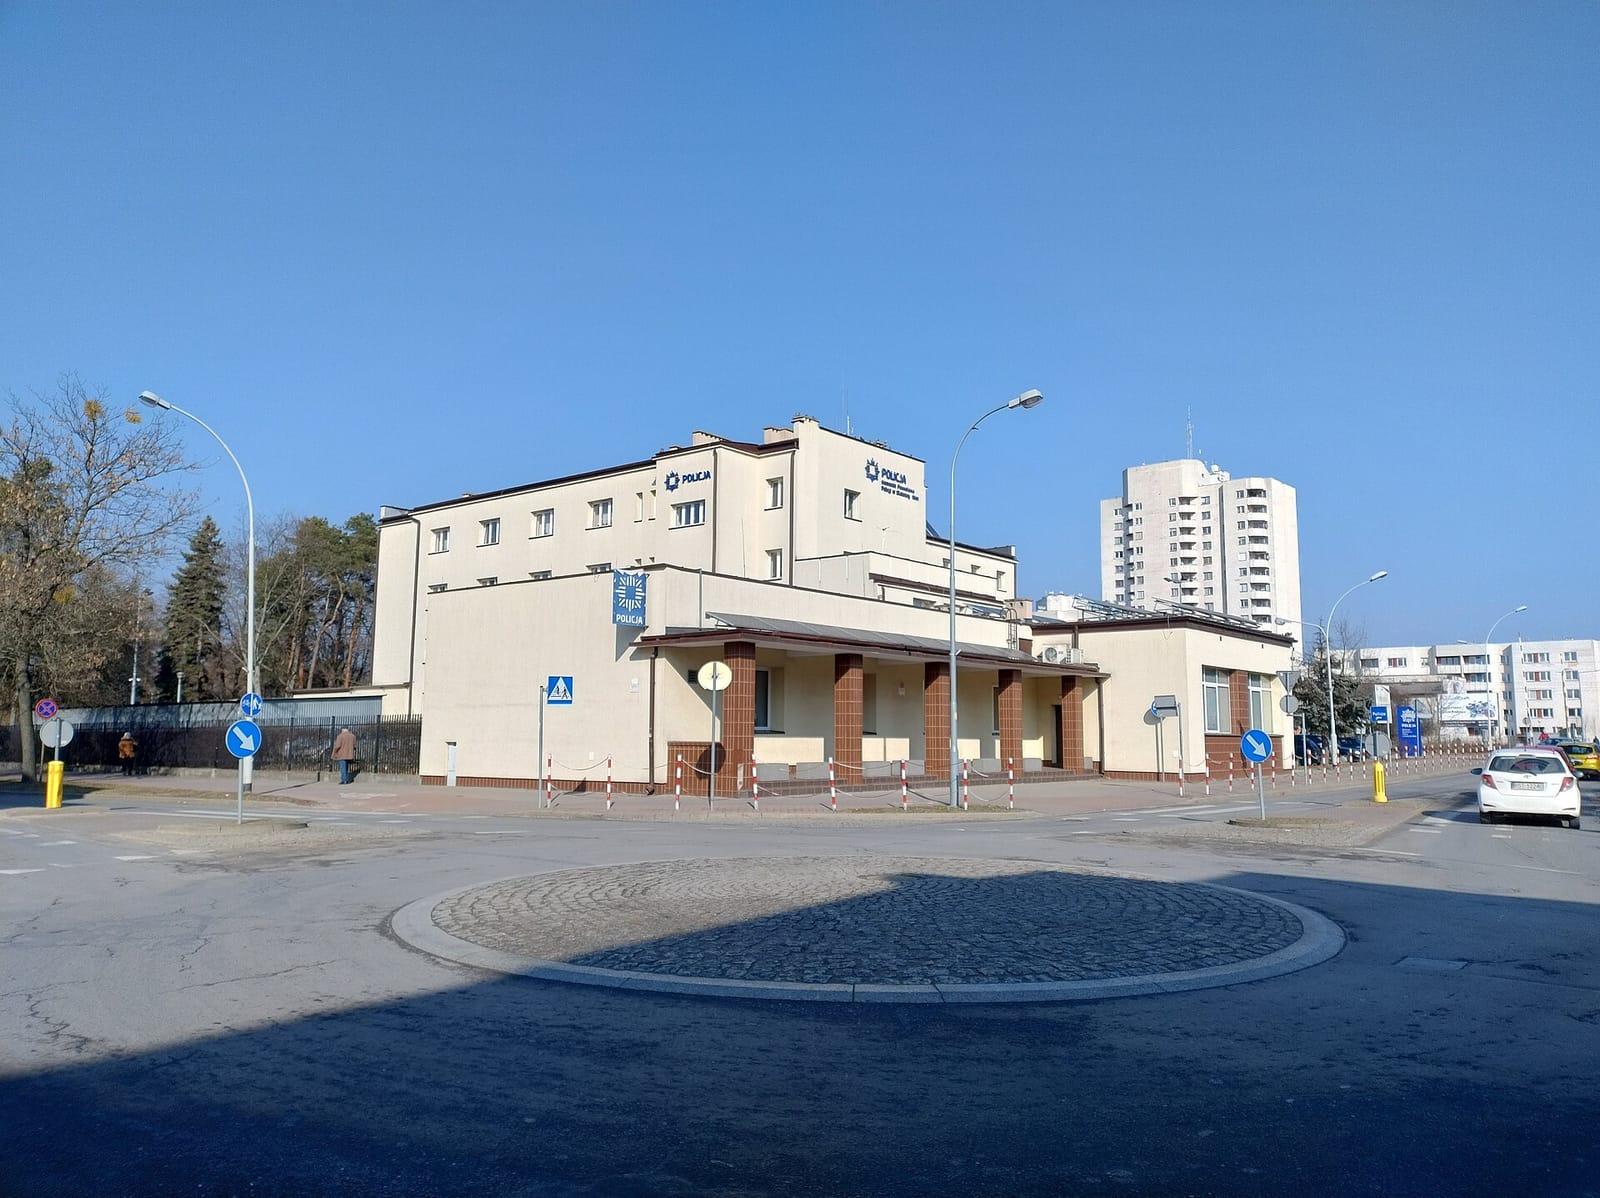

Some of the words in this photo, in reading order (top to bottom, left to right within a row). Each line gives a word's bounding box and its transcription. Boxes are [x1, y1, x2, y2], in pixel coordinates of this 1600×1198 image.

[682, 470, 711, 484] POLICJA
[881, 468, 906, 484] POLICJA
[616, 614, 643, 624] POLICJA
